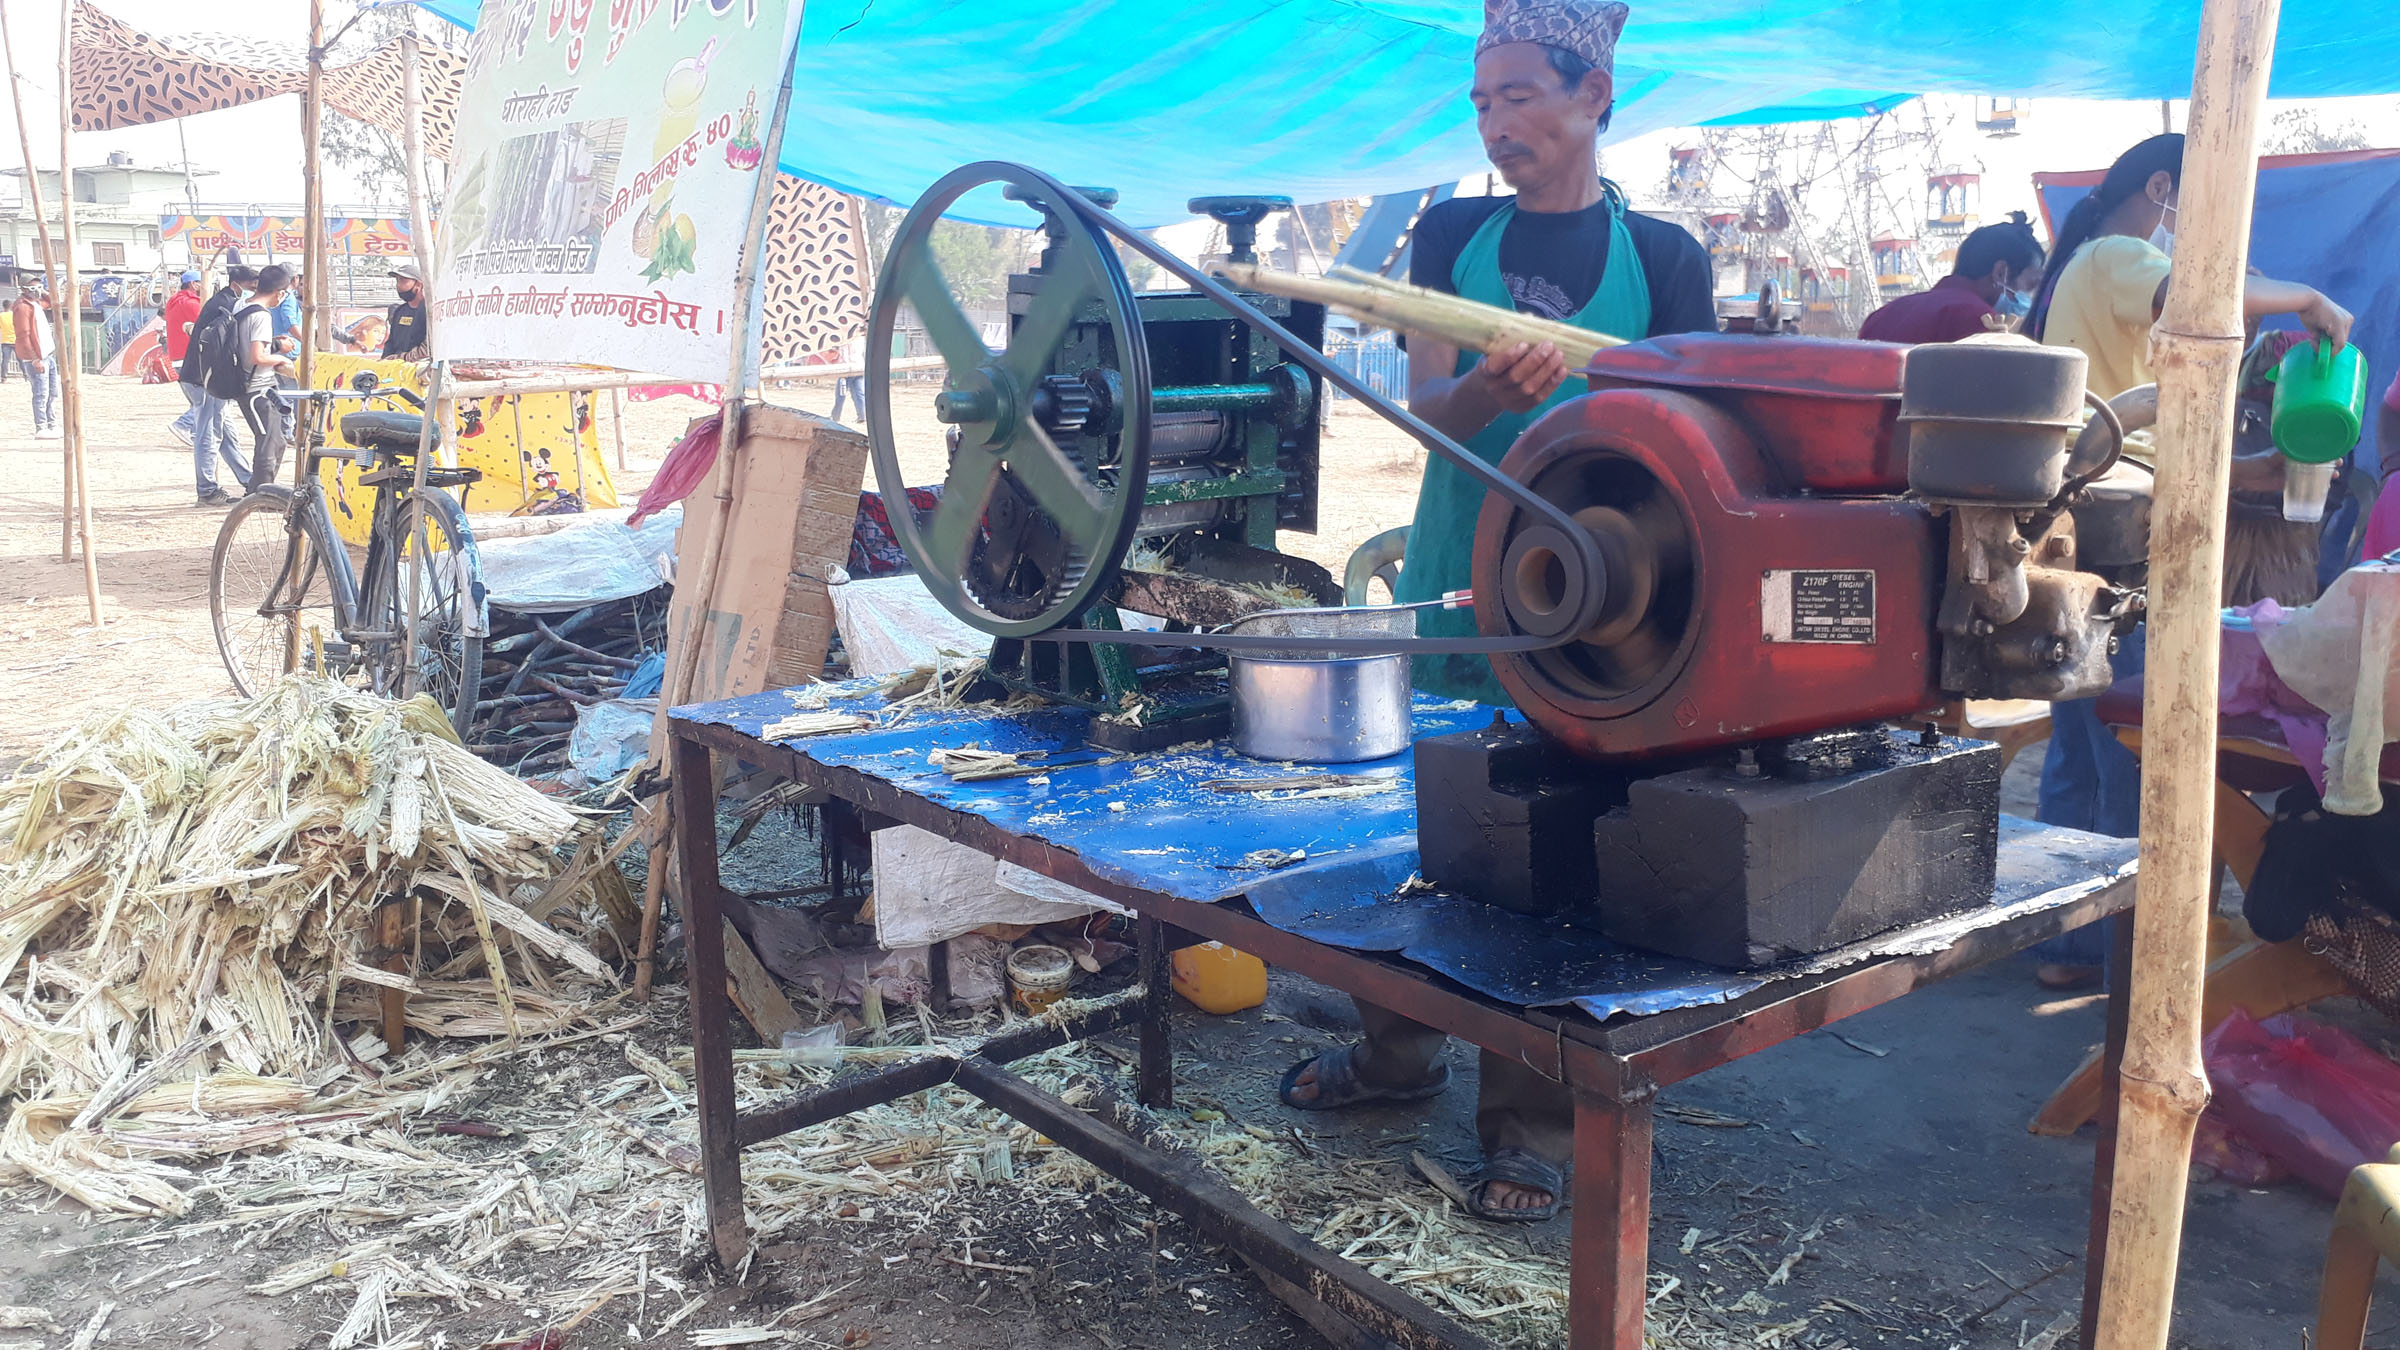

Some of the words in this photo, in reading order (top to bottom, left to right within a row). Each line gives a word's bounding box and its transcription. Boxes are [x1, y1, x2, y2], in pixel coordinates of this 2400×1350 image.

[706, 114, 731, 145] ४०
[534, 240, 563, 272] जीवन
[474, 285, 505, 317] लागि
[505, 285, 569, 319] हामीलाई
[1803, 577, 1828, 587] Z170F
